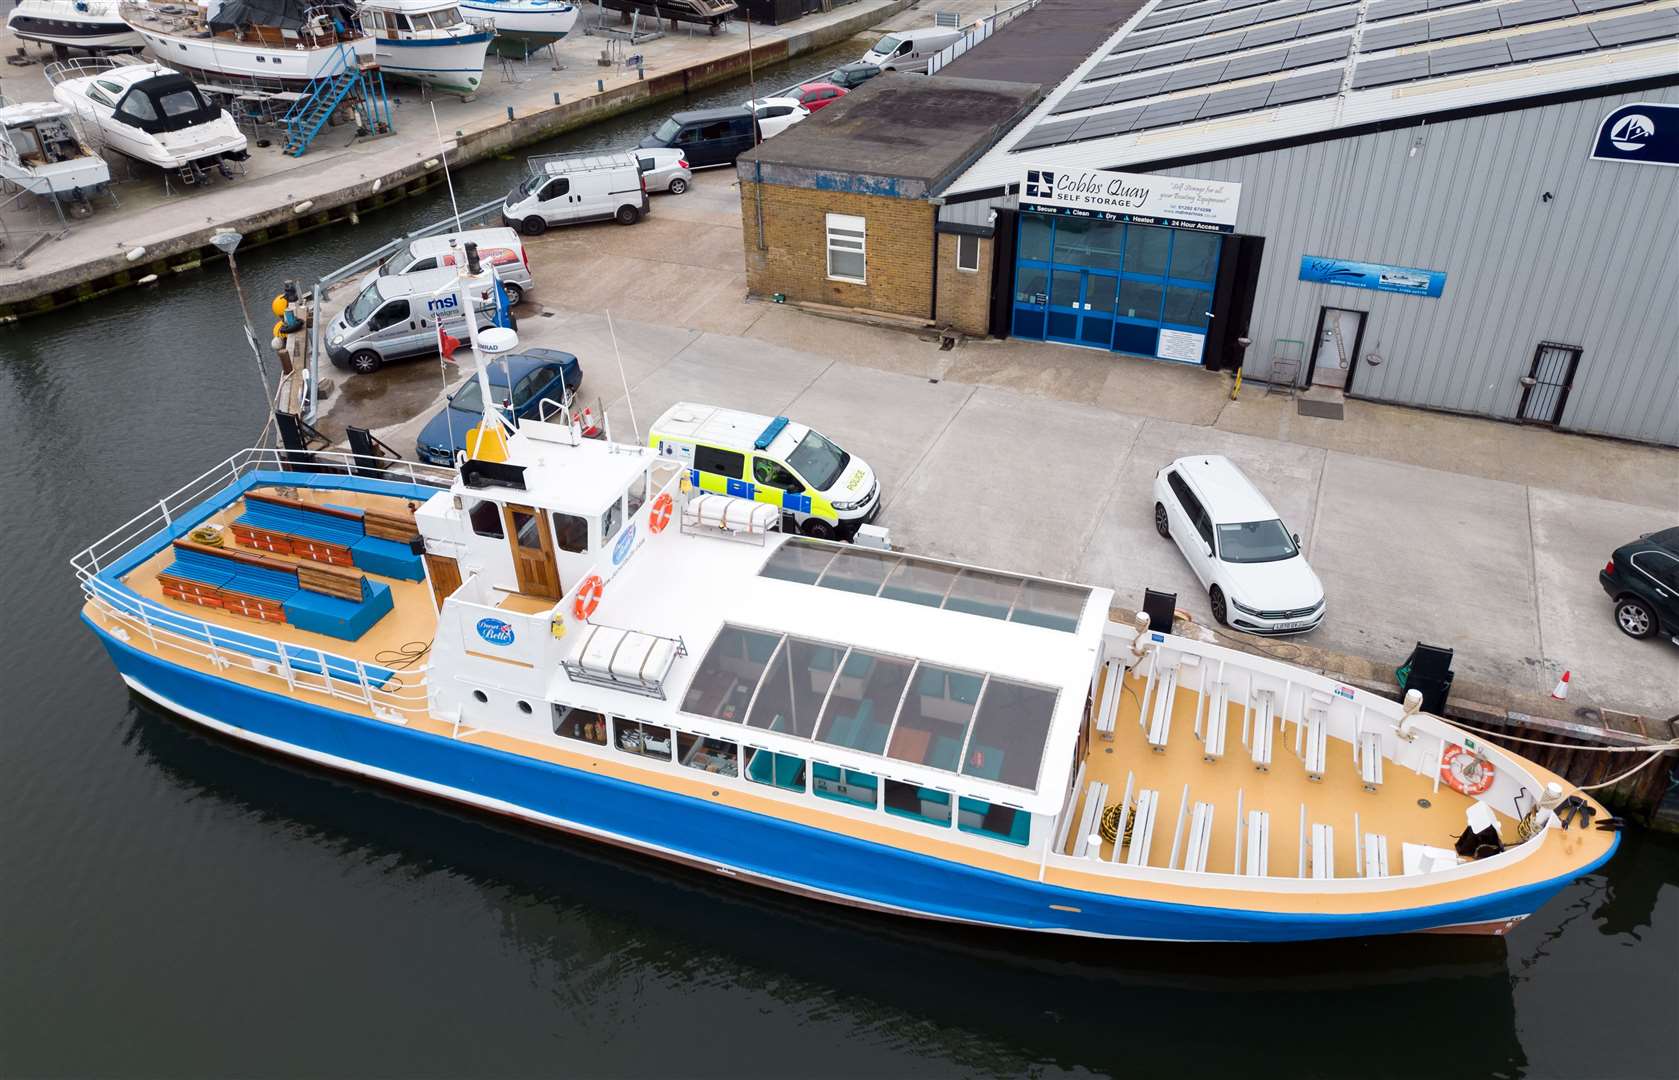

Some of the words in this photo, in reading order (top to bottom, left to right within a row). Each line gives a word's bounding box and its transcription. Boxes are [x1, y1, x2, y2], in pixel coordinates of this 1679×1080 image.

[1057, 173, 1103, 194] Cobbs
[1107, 179, 1150, 208] Quay
[1057, 193, 1081, 201] SELF
[1084, 196, 1131, 207] STORAGE
[1037, 205, 1057, 213] Secure
[1072, 209, 1090, 217] Clean
[1105, 213, 1117, 221] Dry
[428, 293, 458, 311] msl
